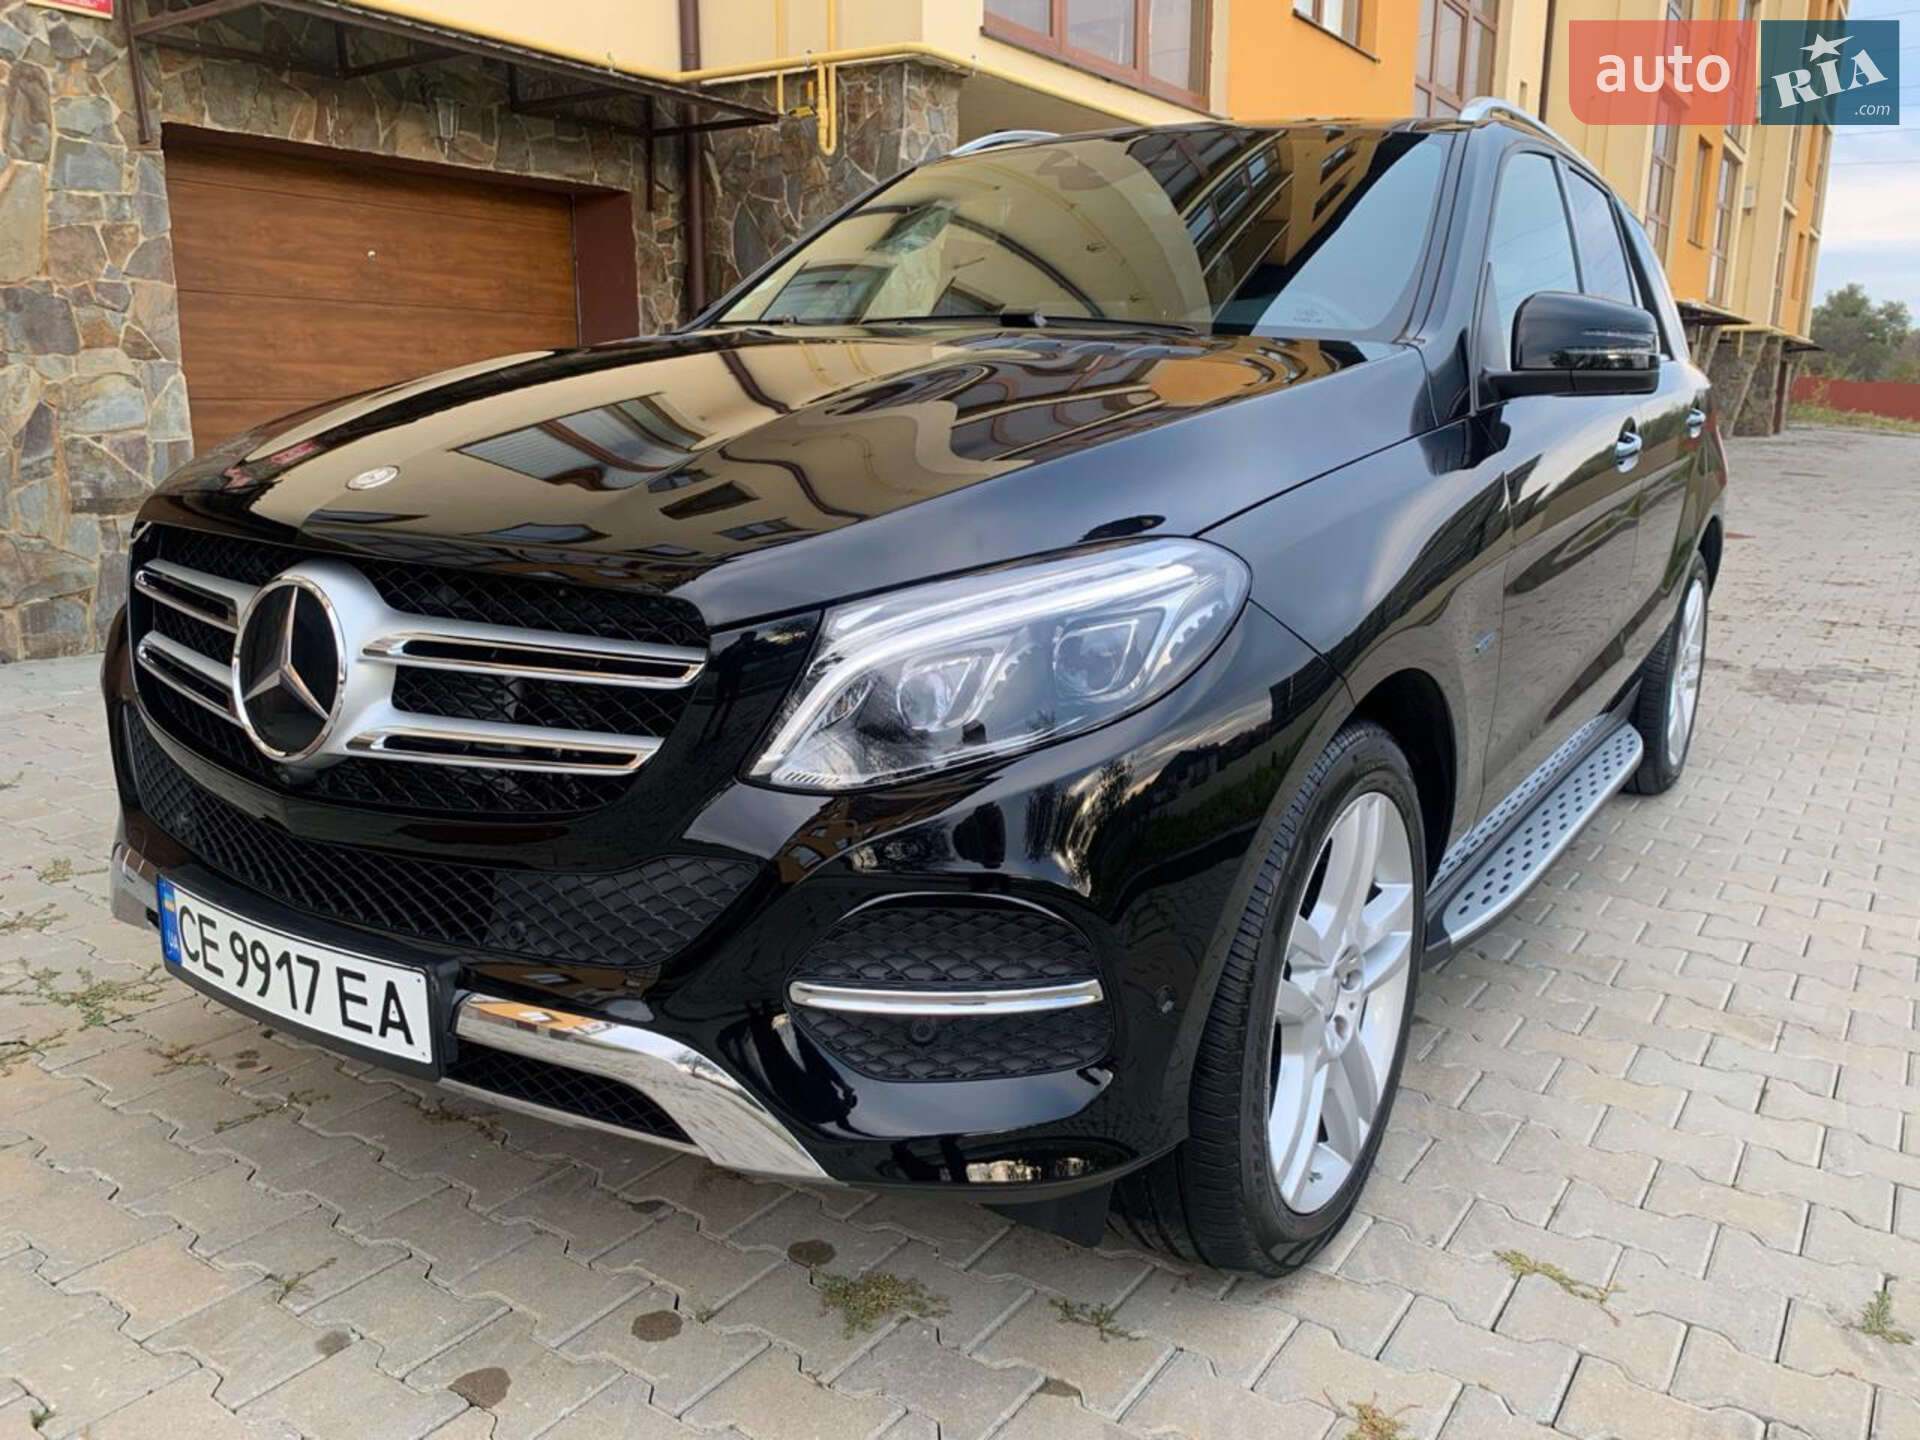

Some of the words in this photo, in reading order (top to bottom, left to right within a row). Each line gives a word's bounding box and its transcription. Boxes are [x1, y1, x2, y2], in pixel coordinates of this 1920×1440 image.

[179, 905, 224, 978] CE
[229, 930, 320, 1015] 9917
[335, 966, 415, 1046] EA
